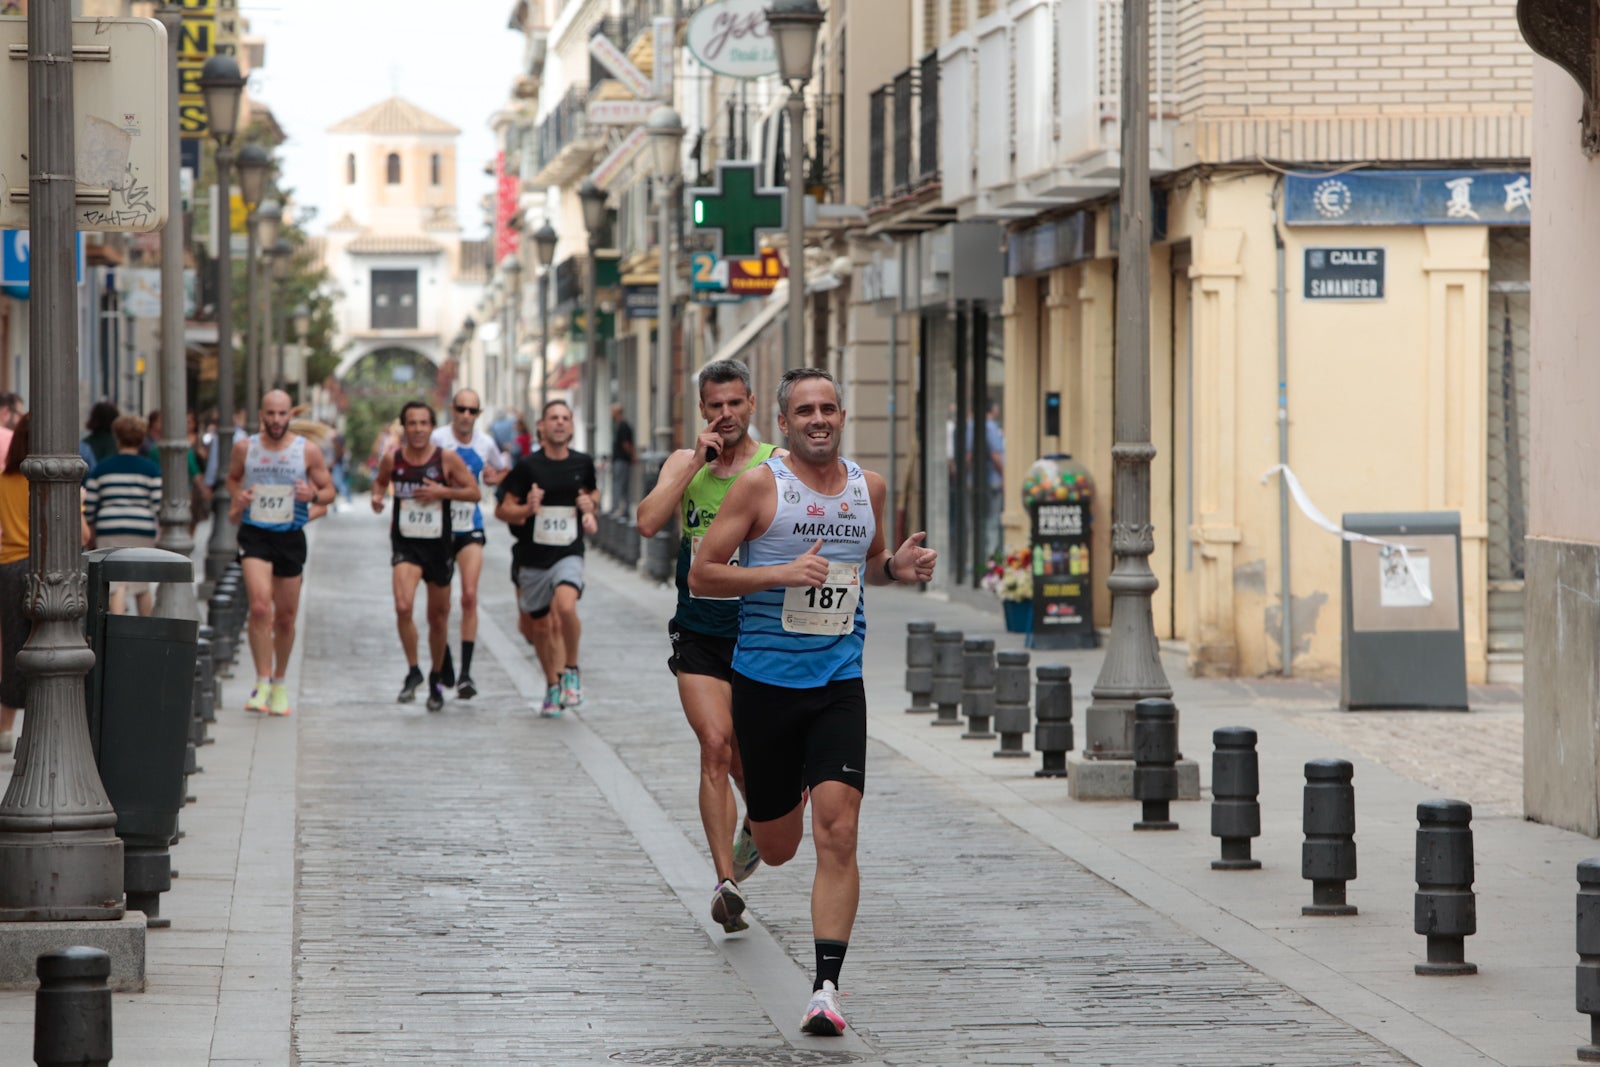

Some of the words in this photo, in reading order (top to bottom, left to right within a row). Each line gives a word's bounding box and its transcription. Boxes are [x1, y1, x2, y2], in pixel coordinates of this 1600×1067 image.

[1329, 250, 1378, 265] CALLE
[1311, 279, 1377, 296] SAMANIEGO
[260, 496, 283, 509] 557
[408, 510, 432, 523] 678
[543, 519, 567, 530] 510
[793, 523, 867, 538] MARACENA
[805, 586, 848, 609] 187
